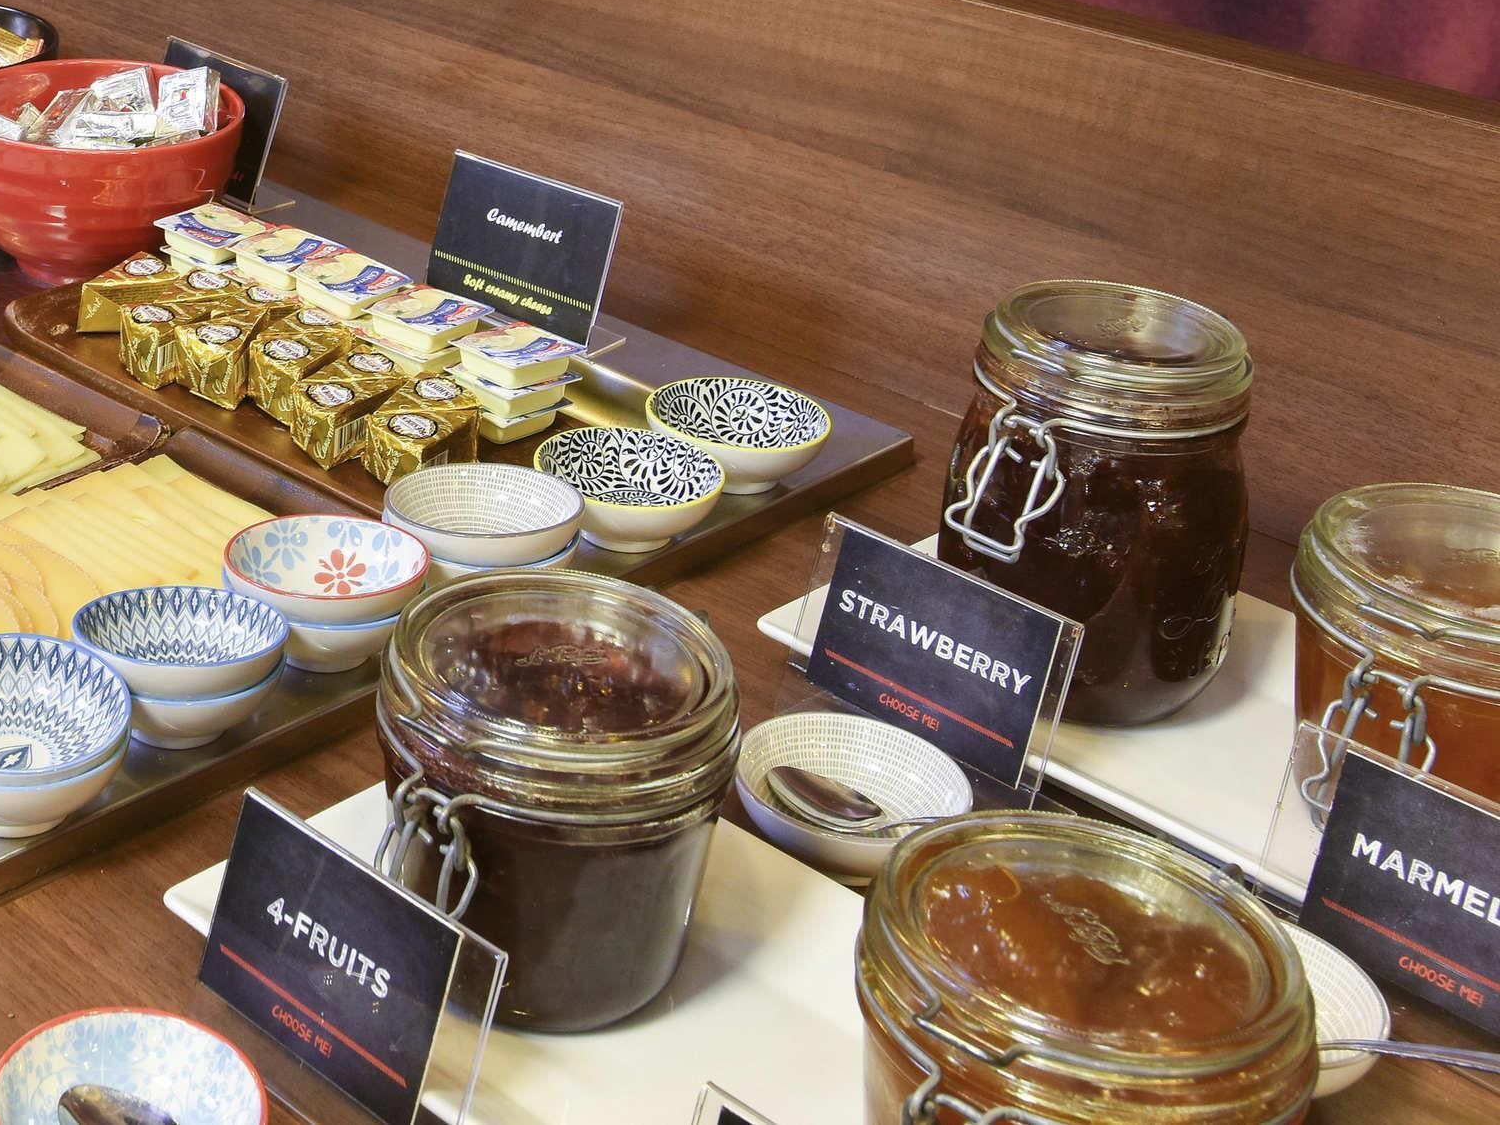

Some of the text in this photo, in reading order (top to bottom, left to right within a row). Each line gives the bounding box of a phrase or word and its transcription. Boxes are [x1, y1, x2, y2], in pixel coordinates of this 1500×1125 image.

[486, 207, 564, 245] Camembert
[463, 273, 553, 317] Soft creamy cheese
[838, 588, 1033, 696] STRAWBERRY
[878, 692, 940, 732] CHOOSE ME!
[266, 897, 392, 1000] 4-FRUITS
[1398, 955, 1486, 1010] CHOOSE ME!
[271, 1004, 334, 1059] CHOOSE ME!
